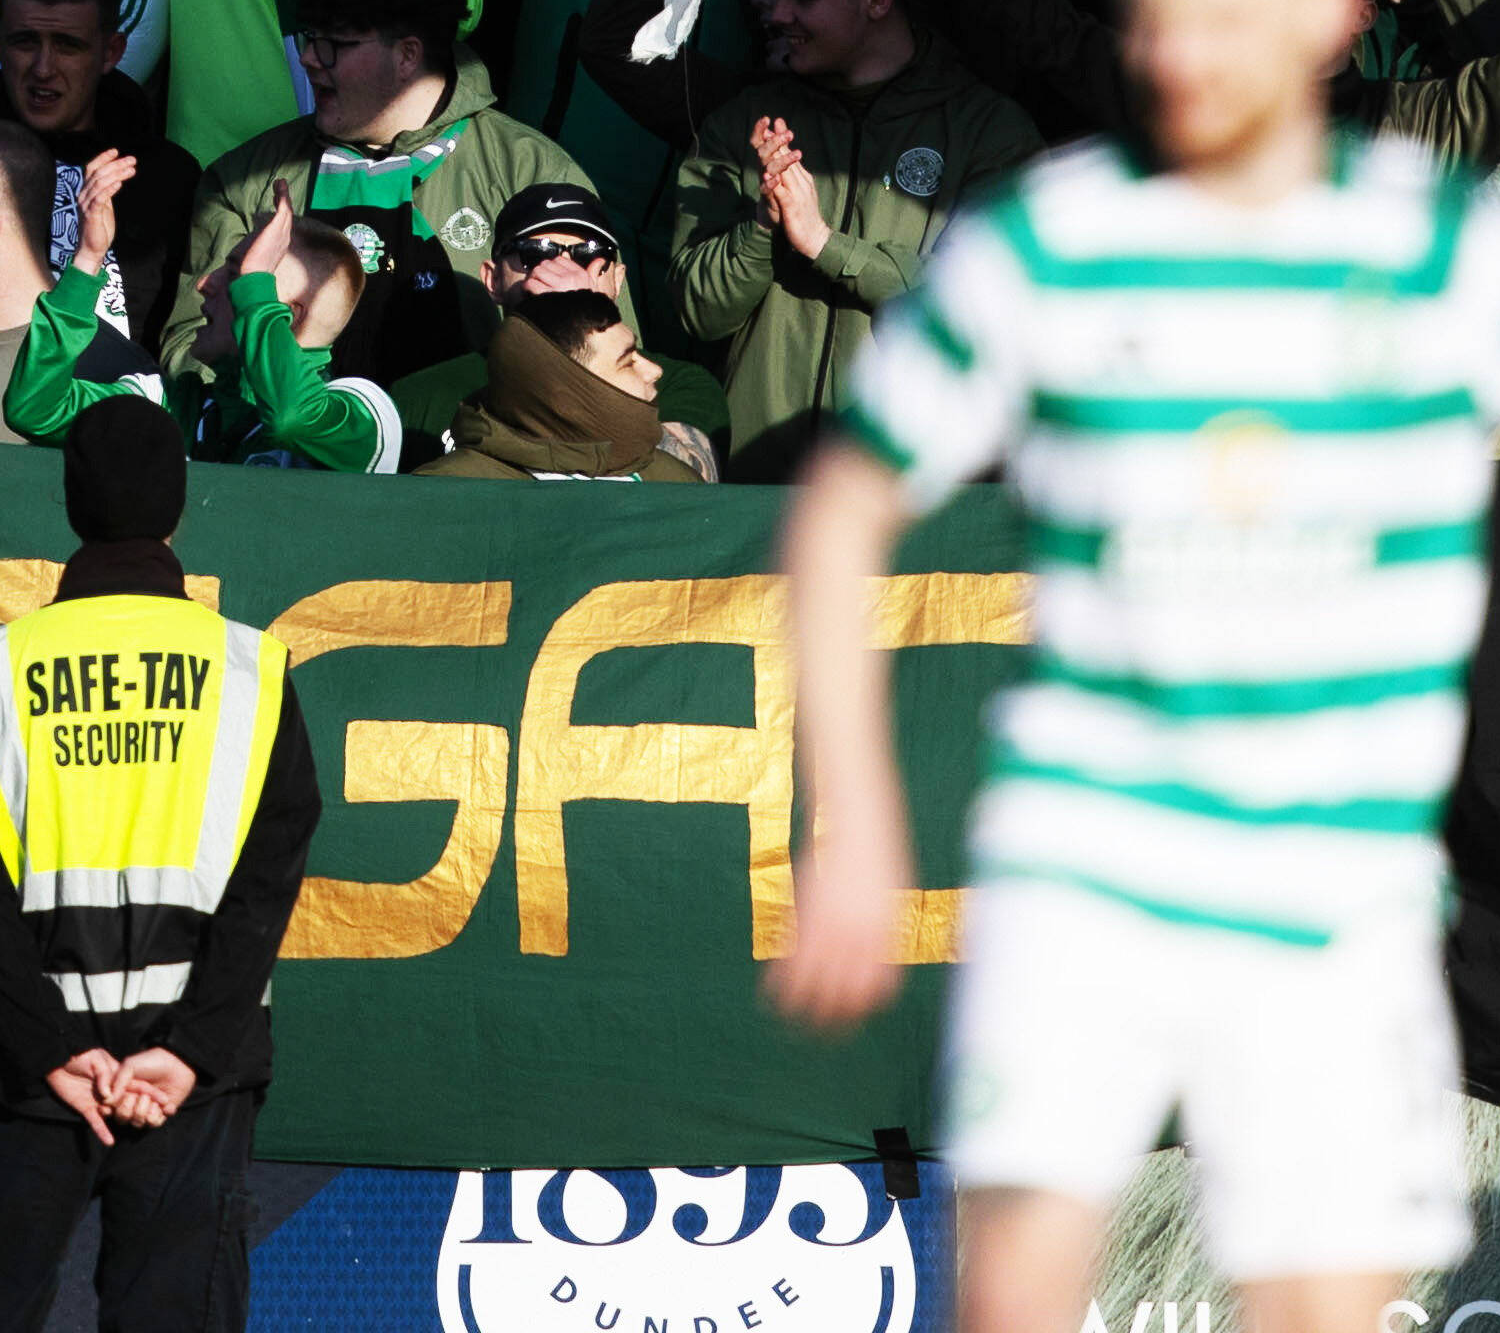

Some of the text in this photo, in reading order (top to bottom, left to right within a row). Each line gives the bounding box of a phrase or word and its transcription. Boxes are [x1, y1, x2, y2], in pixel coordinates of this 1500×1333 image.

[26, 649, 211, 721] SAFE-TAY
[53, 718, 185, 770] SECURITY
[549, 1225, 801, 1333] DUNDEE
